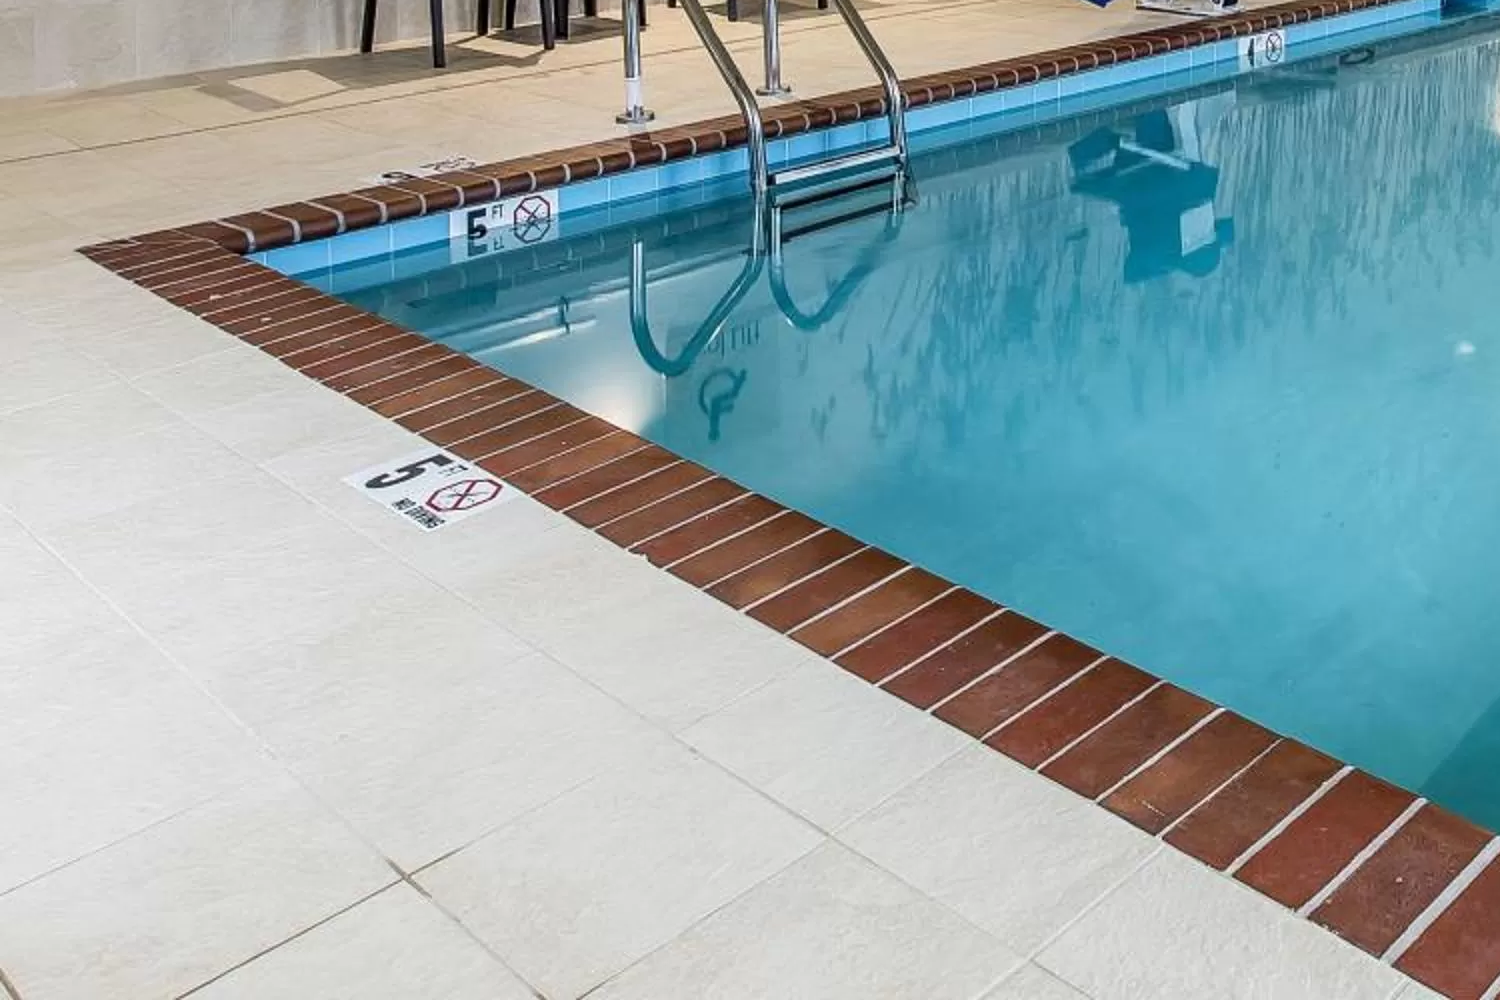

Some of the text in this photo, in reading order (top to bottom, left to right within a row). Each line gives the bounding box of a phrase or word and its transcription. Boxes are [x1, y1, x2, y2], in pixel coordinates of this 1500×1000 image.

[467, 203, 505, 240] 5 FT
[365, 454, 454, 488] 5
